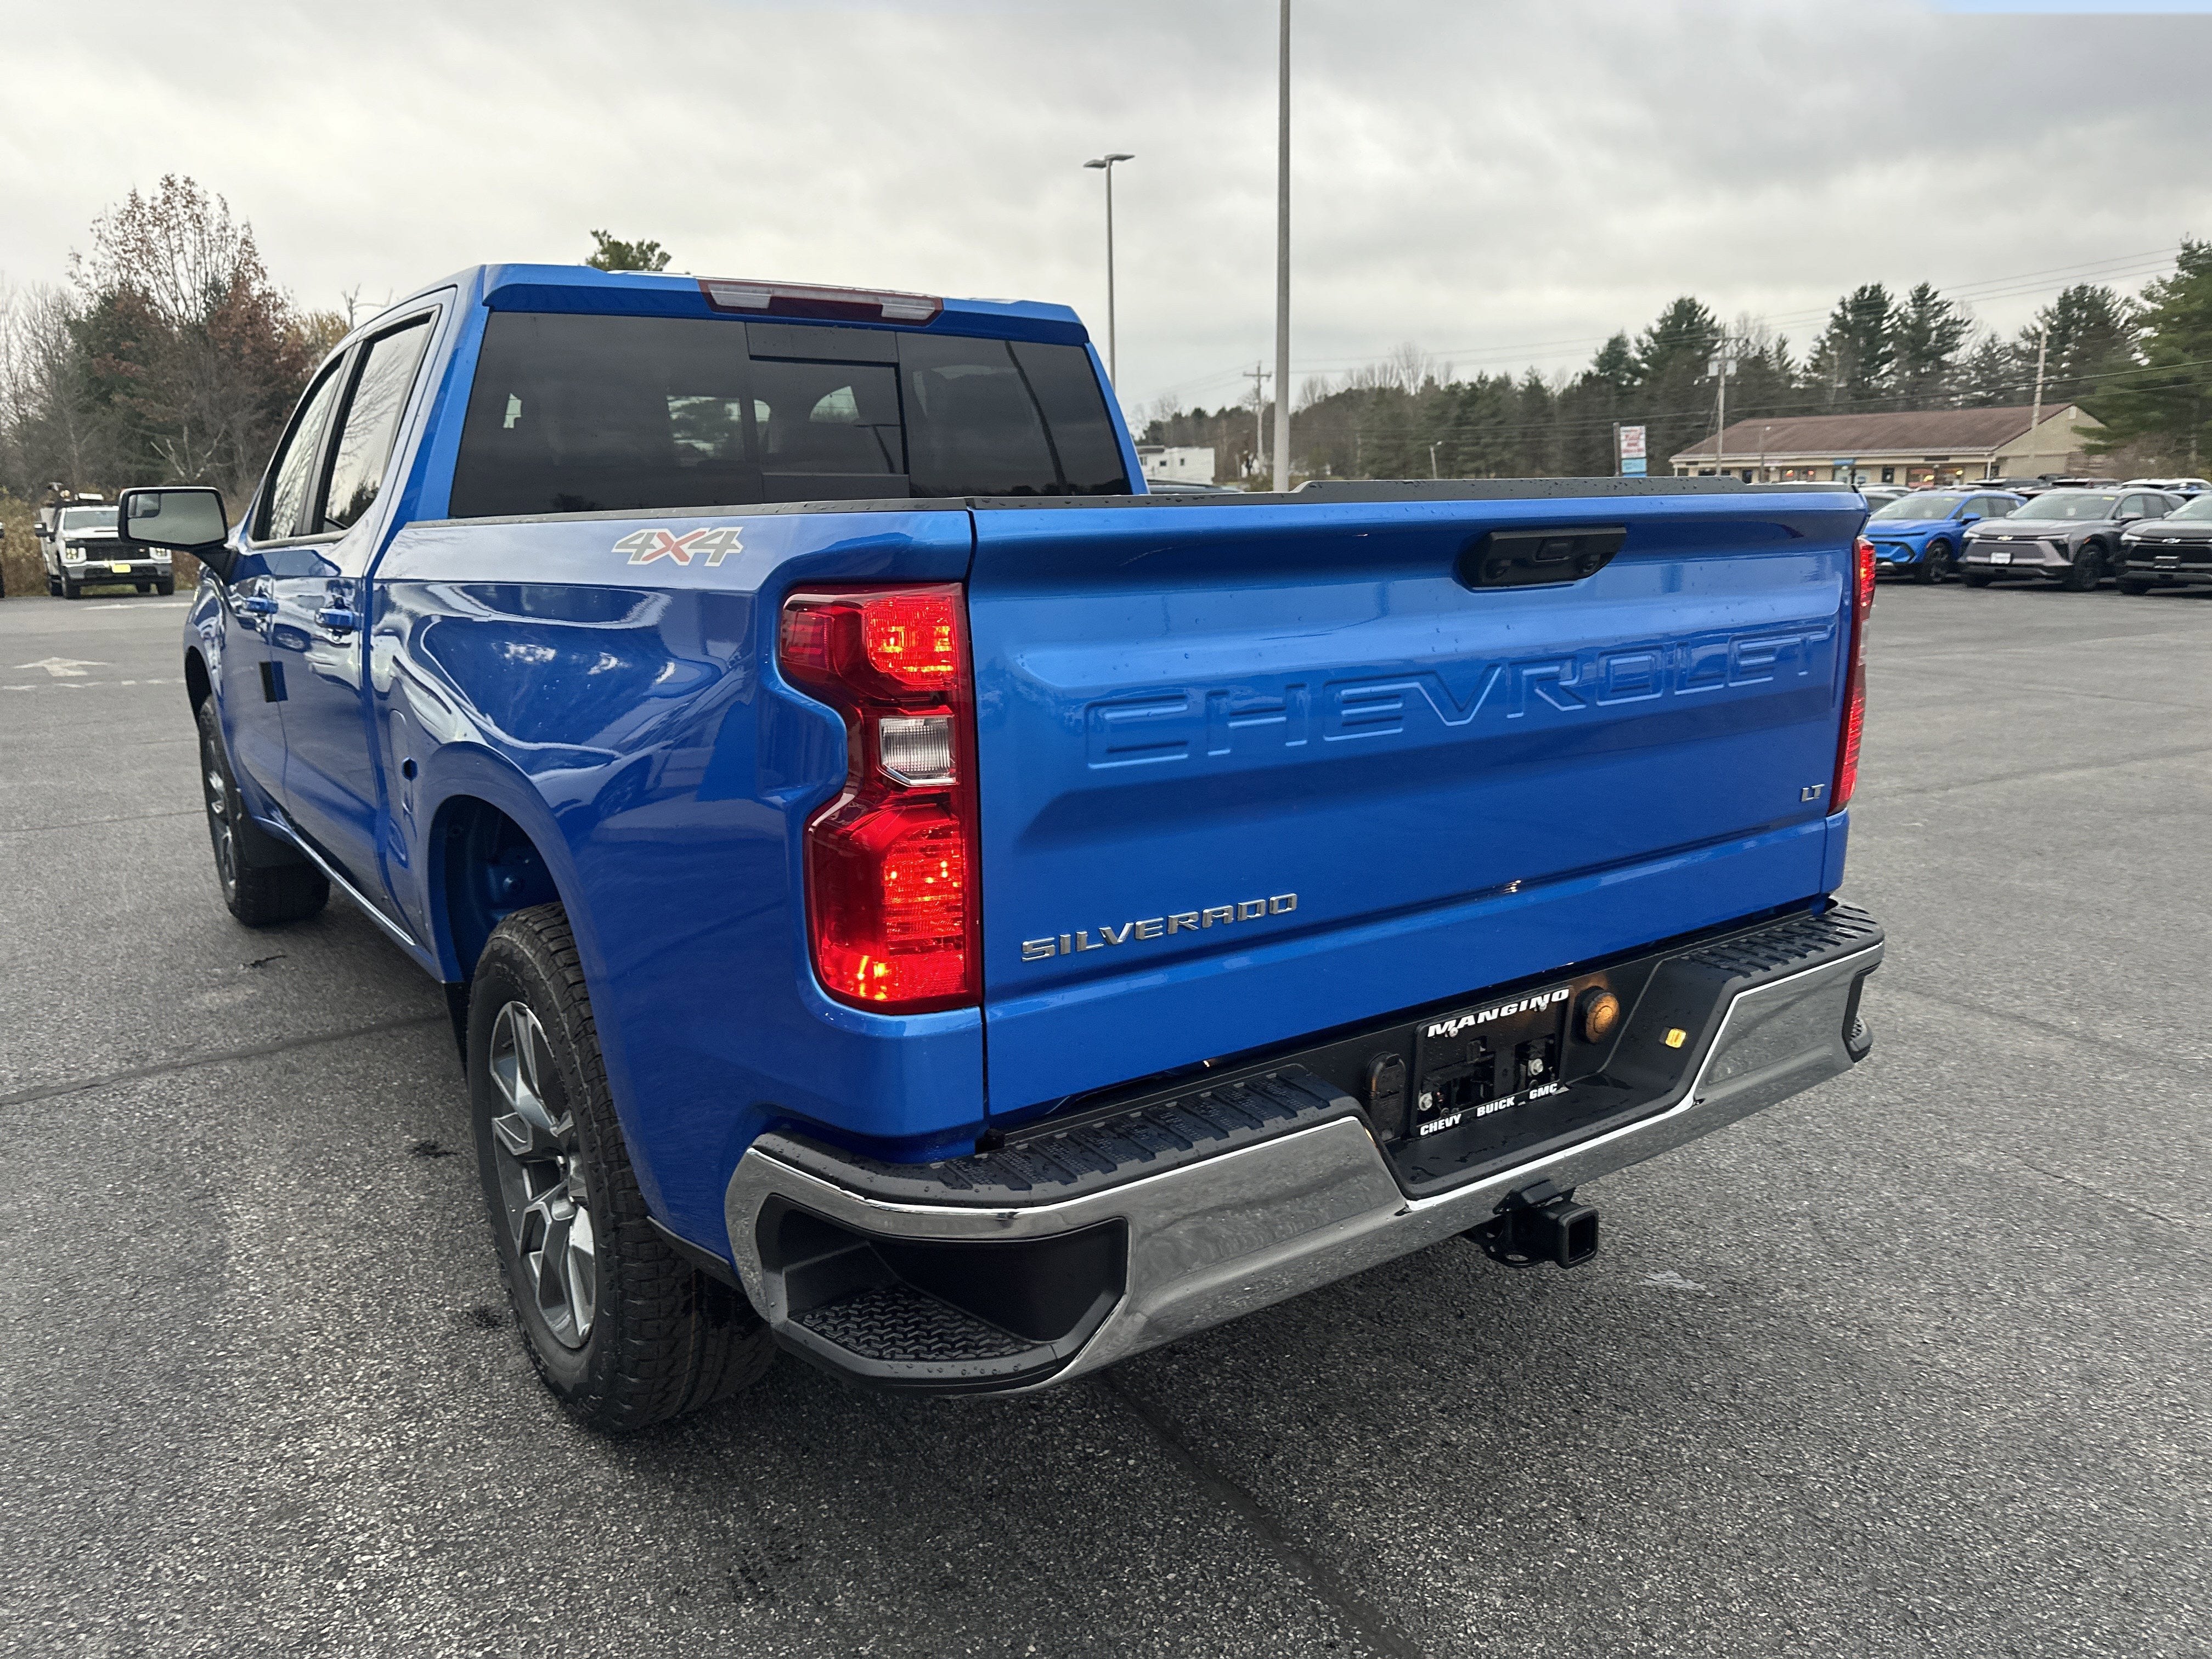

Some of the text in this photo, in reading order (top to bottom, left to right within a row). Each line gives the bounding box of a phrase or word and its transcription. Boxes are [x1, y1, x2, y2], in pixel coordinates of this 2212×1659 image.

[1085, 623, 1833, 769] CHEVROLET
[1801, 783, 1825, 802] LT
[1022, 893, 1297, 962] SILVERADO
[1427, 988, 1570, 1037] MANGINO
[1420, 1082, 1558, 1136] CHEVY BUICK GMC
